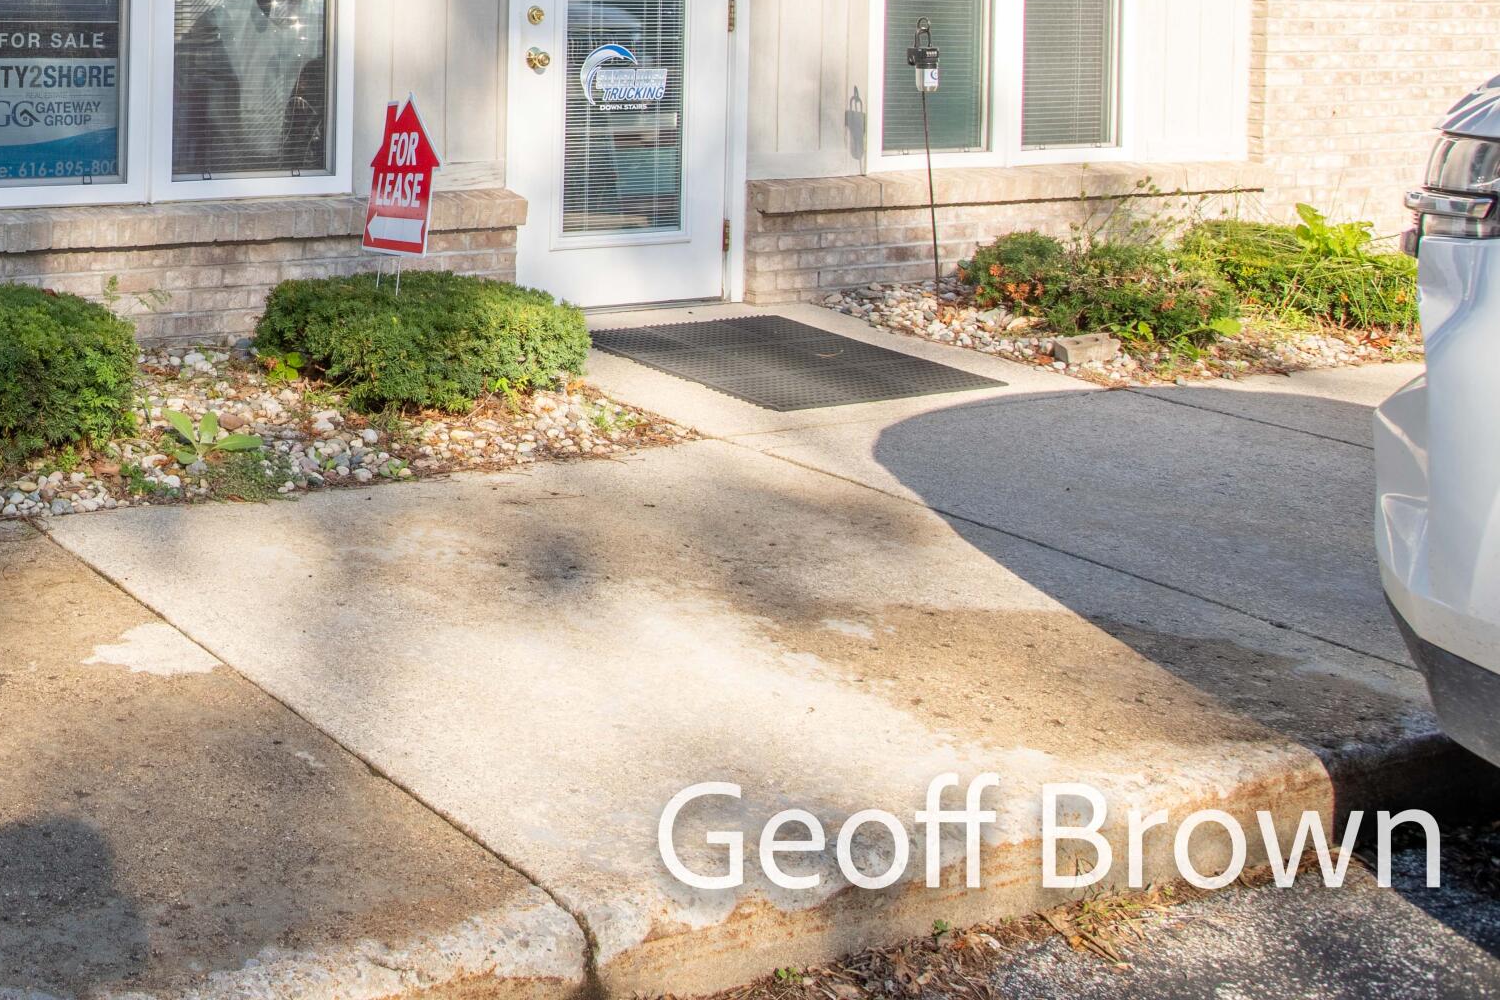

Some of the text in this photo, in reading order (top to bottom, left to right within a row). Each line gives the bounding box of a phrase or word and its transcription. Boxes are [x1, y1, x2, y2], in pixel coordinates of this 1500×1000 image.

[50, 31, 105, 49] SALE
[603, 86, 665, 100] TRUCKING
[35, 101, 101, 114] GATEWAY
[44, 114, 92, 126] GROUP
[387, 131, 420, 167] FOR
[375, 172, 425, 208] LEASE
